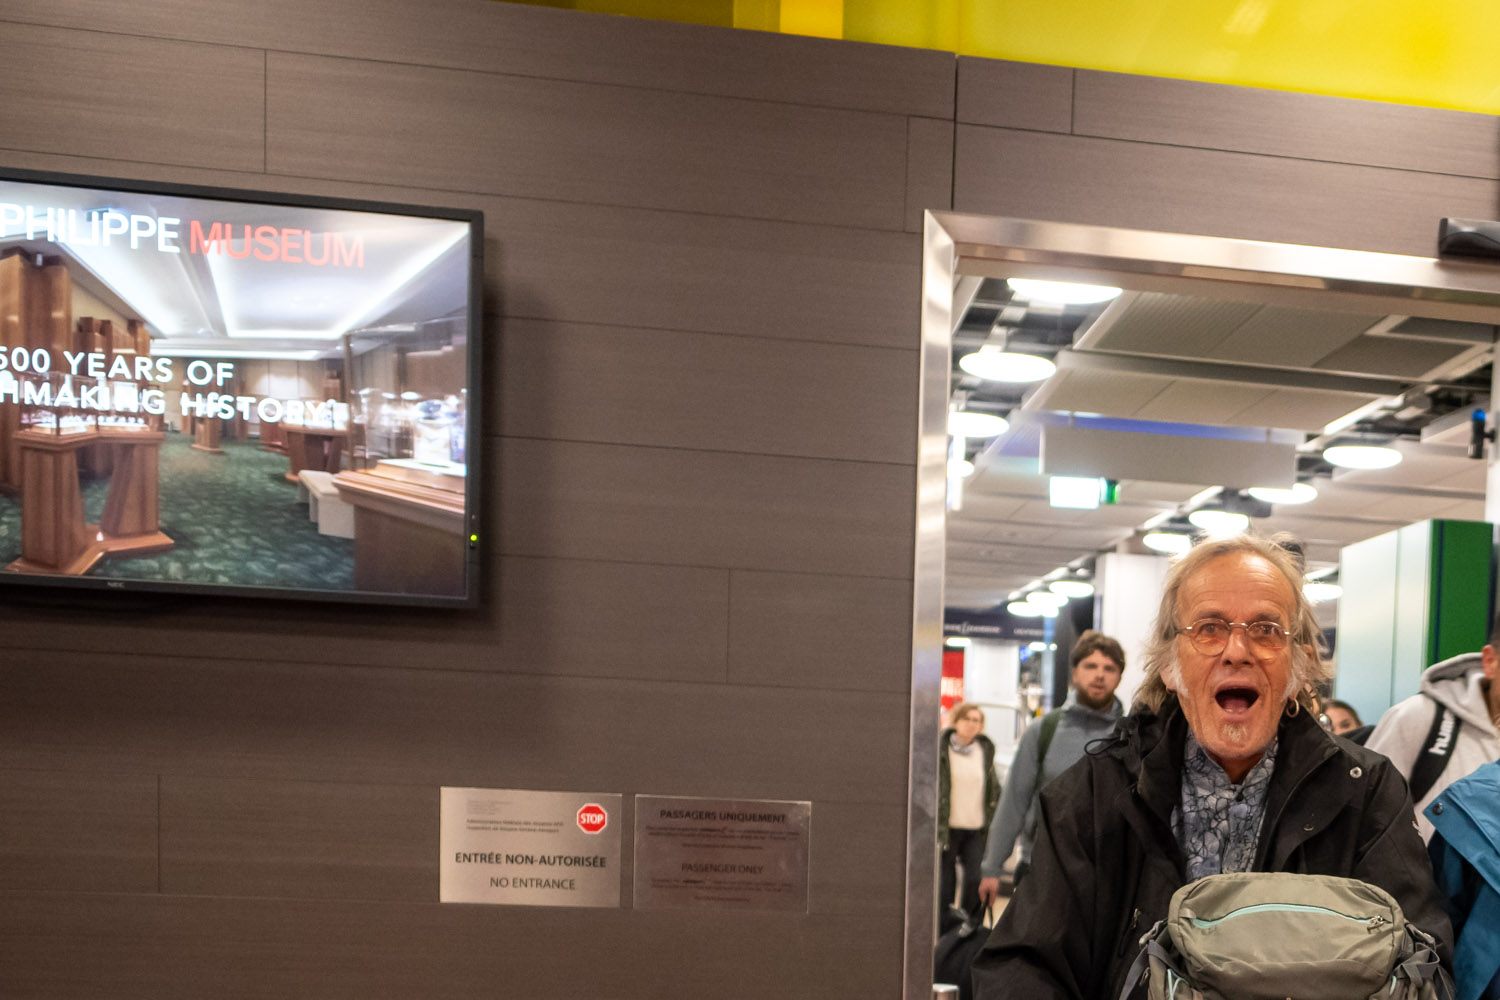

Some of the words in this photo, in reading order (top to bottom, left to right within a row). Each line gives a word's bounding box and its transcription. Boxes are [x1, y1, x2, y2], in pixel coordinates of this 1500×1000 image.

[0, 202, 181, 253] PHILIPPE
[190, 219, 365, 269] MUSEUM
[63, 351, 173, 383] YEARS
[187, 360, 234, 387] OF
[580, 812, 604, 825] STOP
[660, 809, 716, 821] PASSAGERS
[719, 811, 787, 824] UNIQUEMENT
[455, 852, 502, 865] ENTRÉE
[505, 853, 607, 868] NON-AUTORISÉE
[681, 863, 736, 874] PASSENGER
[738, 864, 764, 875] ONLY
[490, 877, 509, 888] NO
[512, 877, 576, 890] ENTRANCE
